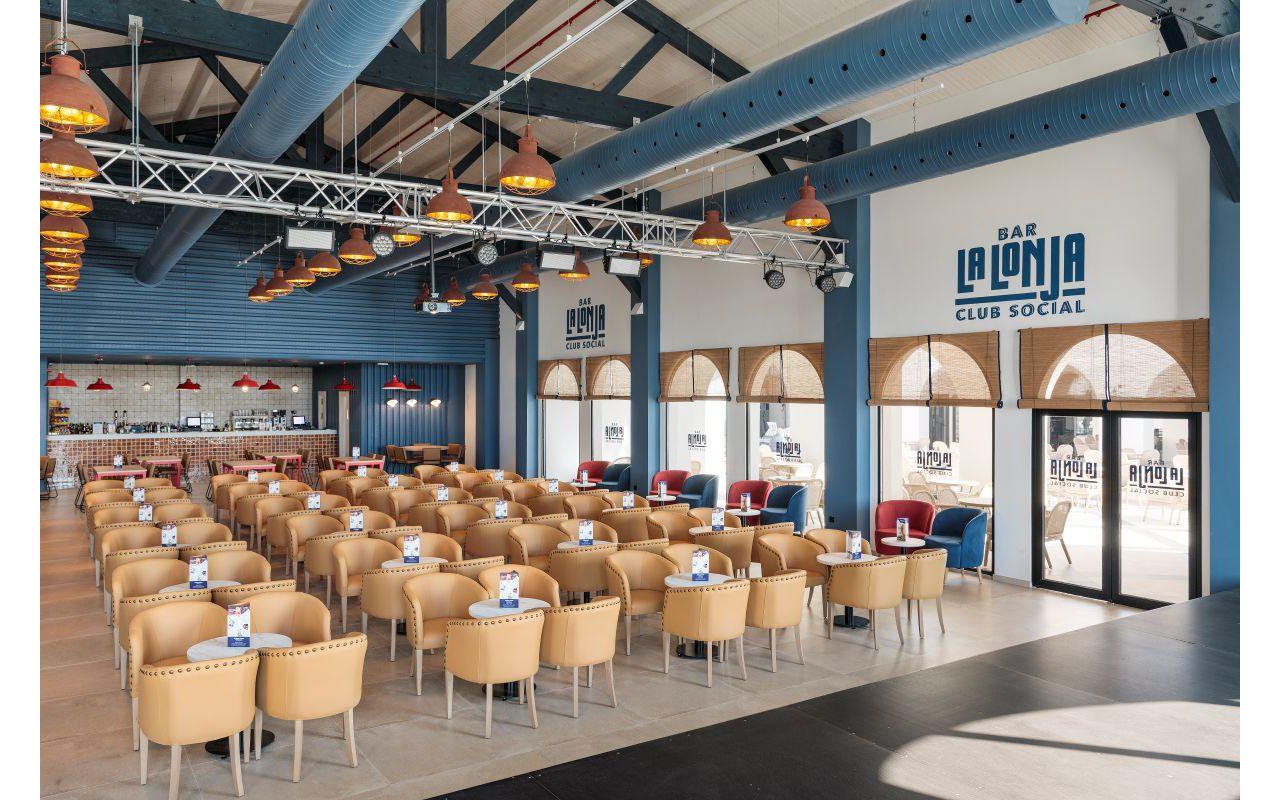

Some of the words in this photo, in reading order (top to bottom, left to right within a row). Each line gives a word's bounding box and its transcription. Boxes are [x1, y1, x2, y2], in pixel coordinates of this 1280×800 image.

[998, 222, 1037, 241] BAR
[957, 246, 986, 294] LA
[991, 232, 1086, 301] LONJA
[578, 297, 592, 306] BAR
[955, 306, 1001, 321] CLUB
[1009, 300, 1086, 318] SOCIAL
[566, 308, 576, 335] LA
[577, 304, 606, 340] LONJA
[565, 342, 581, 350] CLUB
[582, 340, 606, 349] SOCIAL
